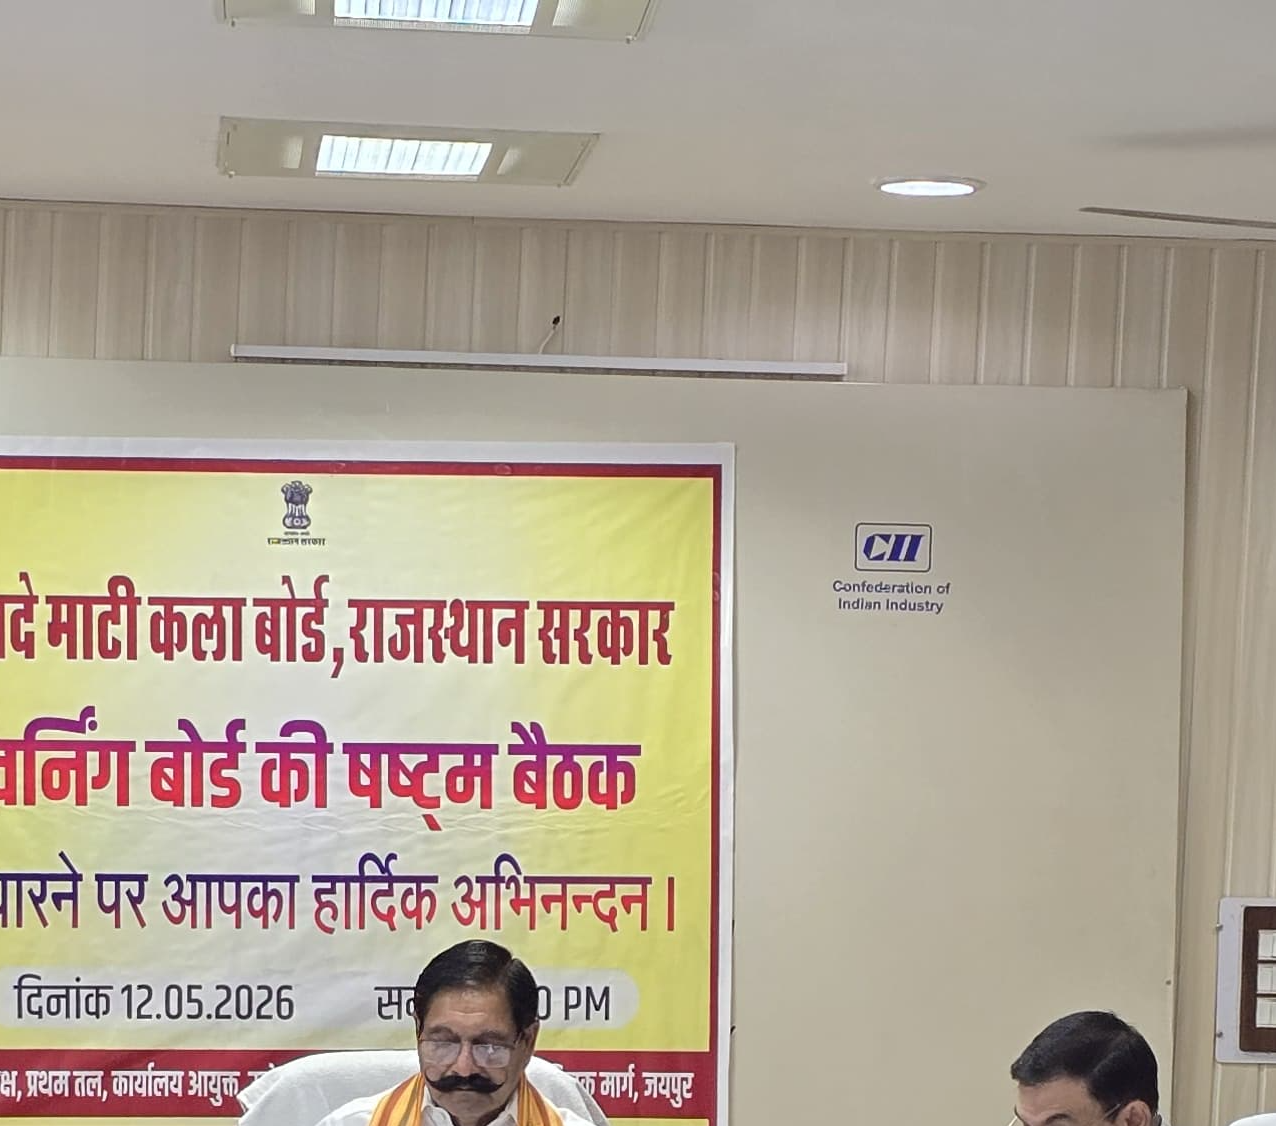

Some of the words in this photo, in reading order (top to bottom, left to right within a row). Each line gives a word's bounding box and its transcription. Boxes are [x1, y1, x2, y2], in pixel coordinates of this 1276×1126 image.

[863, 533, 925, 562] CII
[832, 580, 932, 595] Confederation
[936, 582, 951, 595] of
[838, 598, 881, 610] Indian
[886, 598, 944, 614] Industry
[46, 575, 142, 661] माटी
[148, 596, 247, 662] कला
[536, 600, 675, 666] सरकार
[144, 718, 246, 808] बोर्ड
[255, 719, 334, 809] की
[507, 721, 642, 811] बैठक
[95, 873, 149, 930] पर
[161, 873, 300, 930] आपका
[311, 852, 439, 935] हार्दिक
[13, 973, 114, 1020] दिनांक
[120, 984, 295, 1021] 12.05.2026
[564, 986, 611, 1021] PM
[26, 1070, 69, 1098] प्रथम
[72, 1070, 108, 1102] तल,
[111, 1062, 184, 1098] कार्यालय
[599, 1063, 639, 1103] मार्ग,
[642, 1071, 694, 1108] जयपुर
